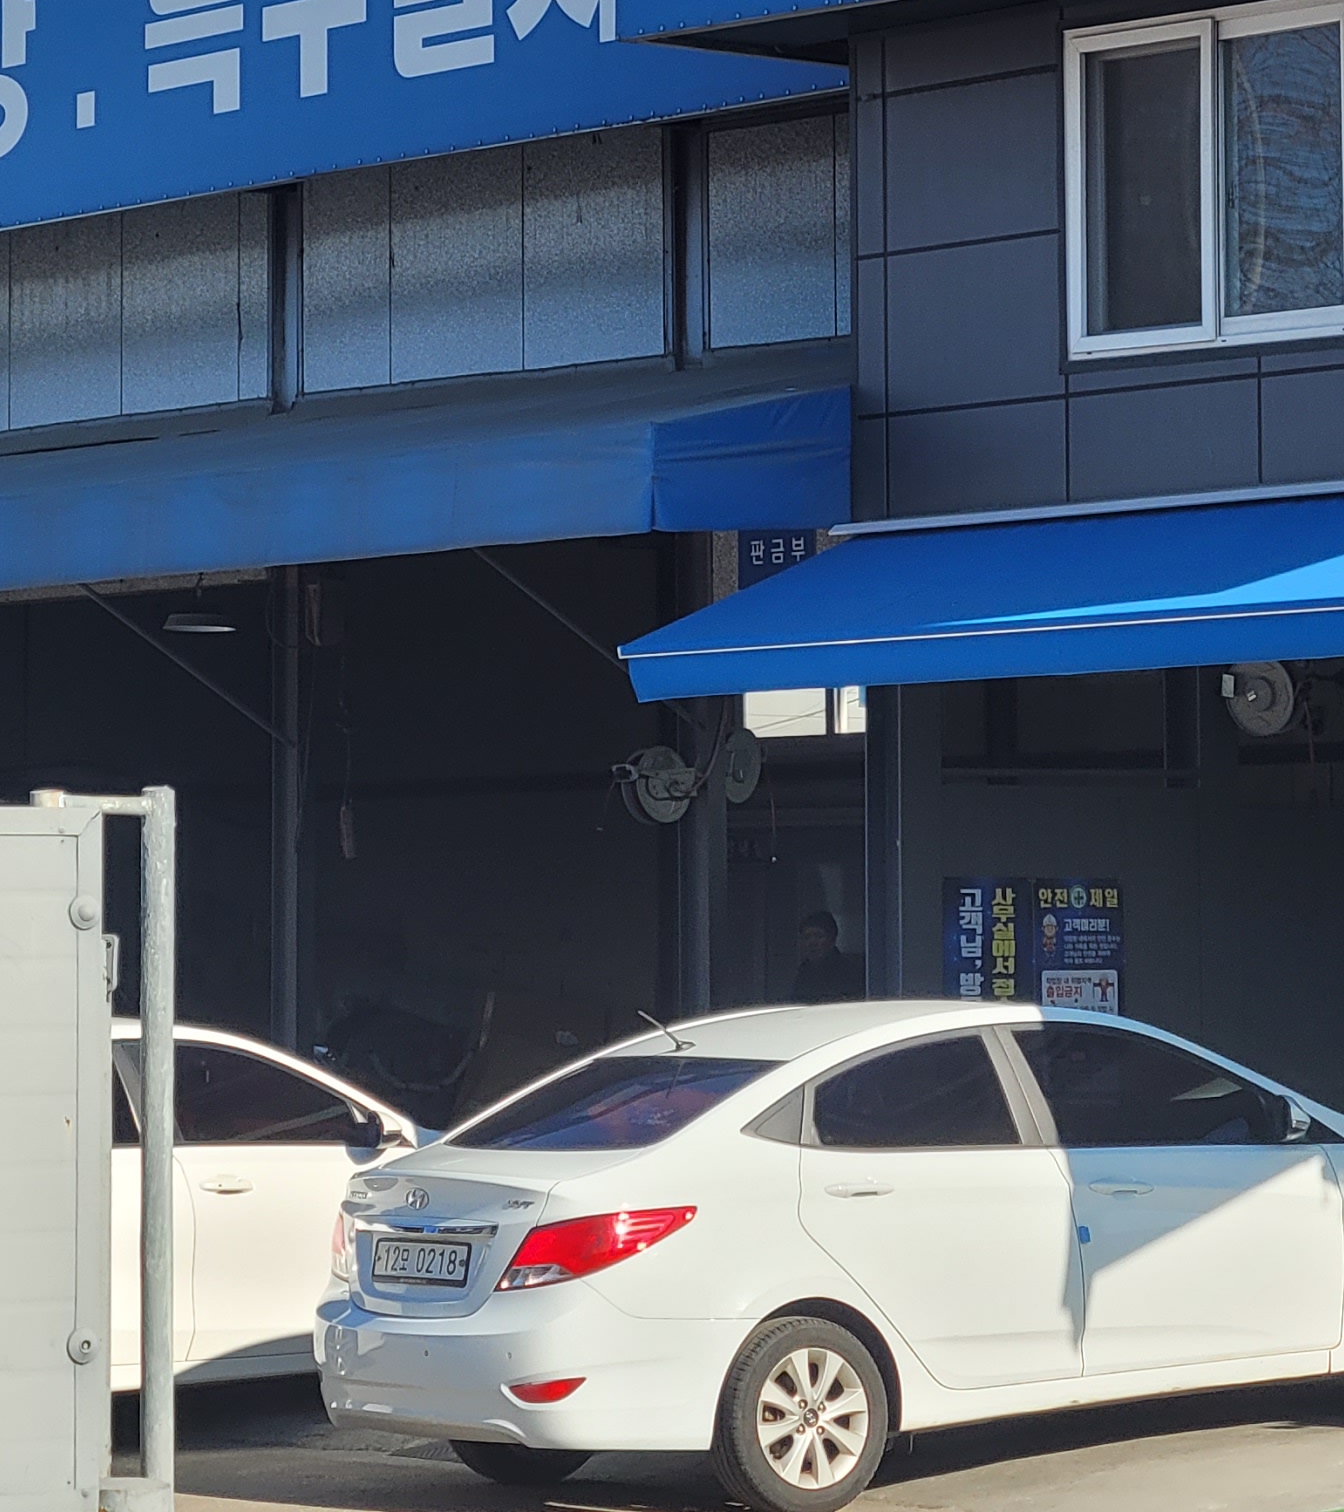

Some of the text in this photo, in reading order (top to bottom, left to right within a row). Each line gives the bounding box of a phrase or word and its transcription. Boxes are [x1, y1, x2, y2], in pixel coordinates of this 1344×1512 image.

[751, 537, 805, 564] 판금부
[1039, 889, 1118, 908] 안전 제일
[959, 889, 984, 1000] 고객님, 방
[992, 888, 1015, 1001] 사무실에서 접
[415, 1246, 459, 1277] 0218
